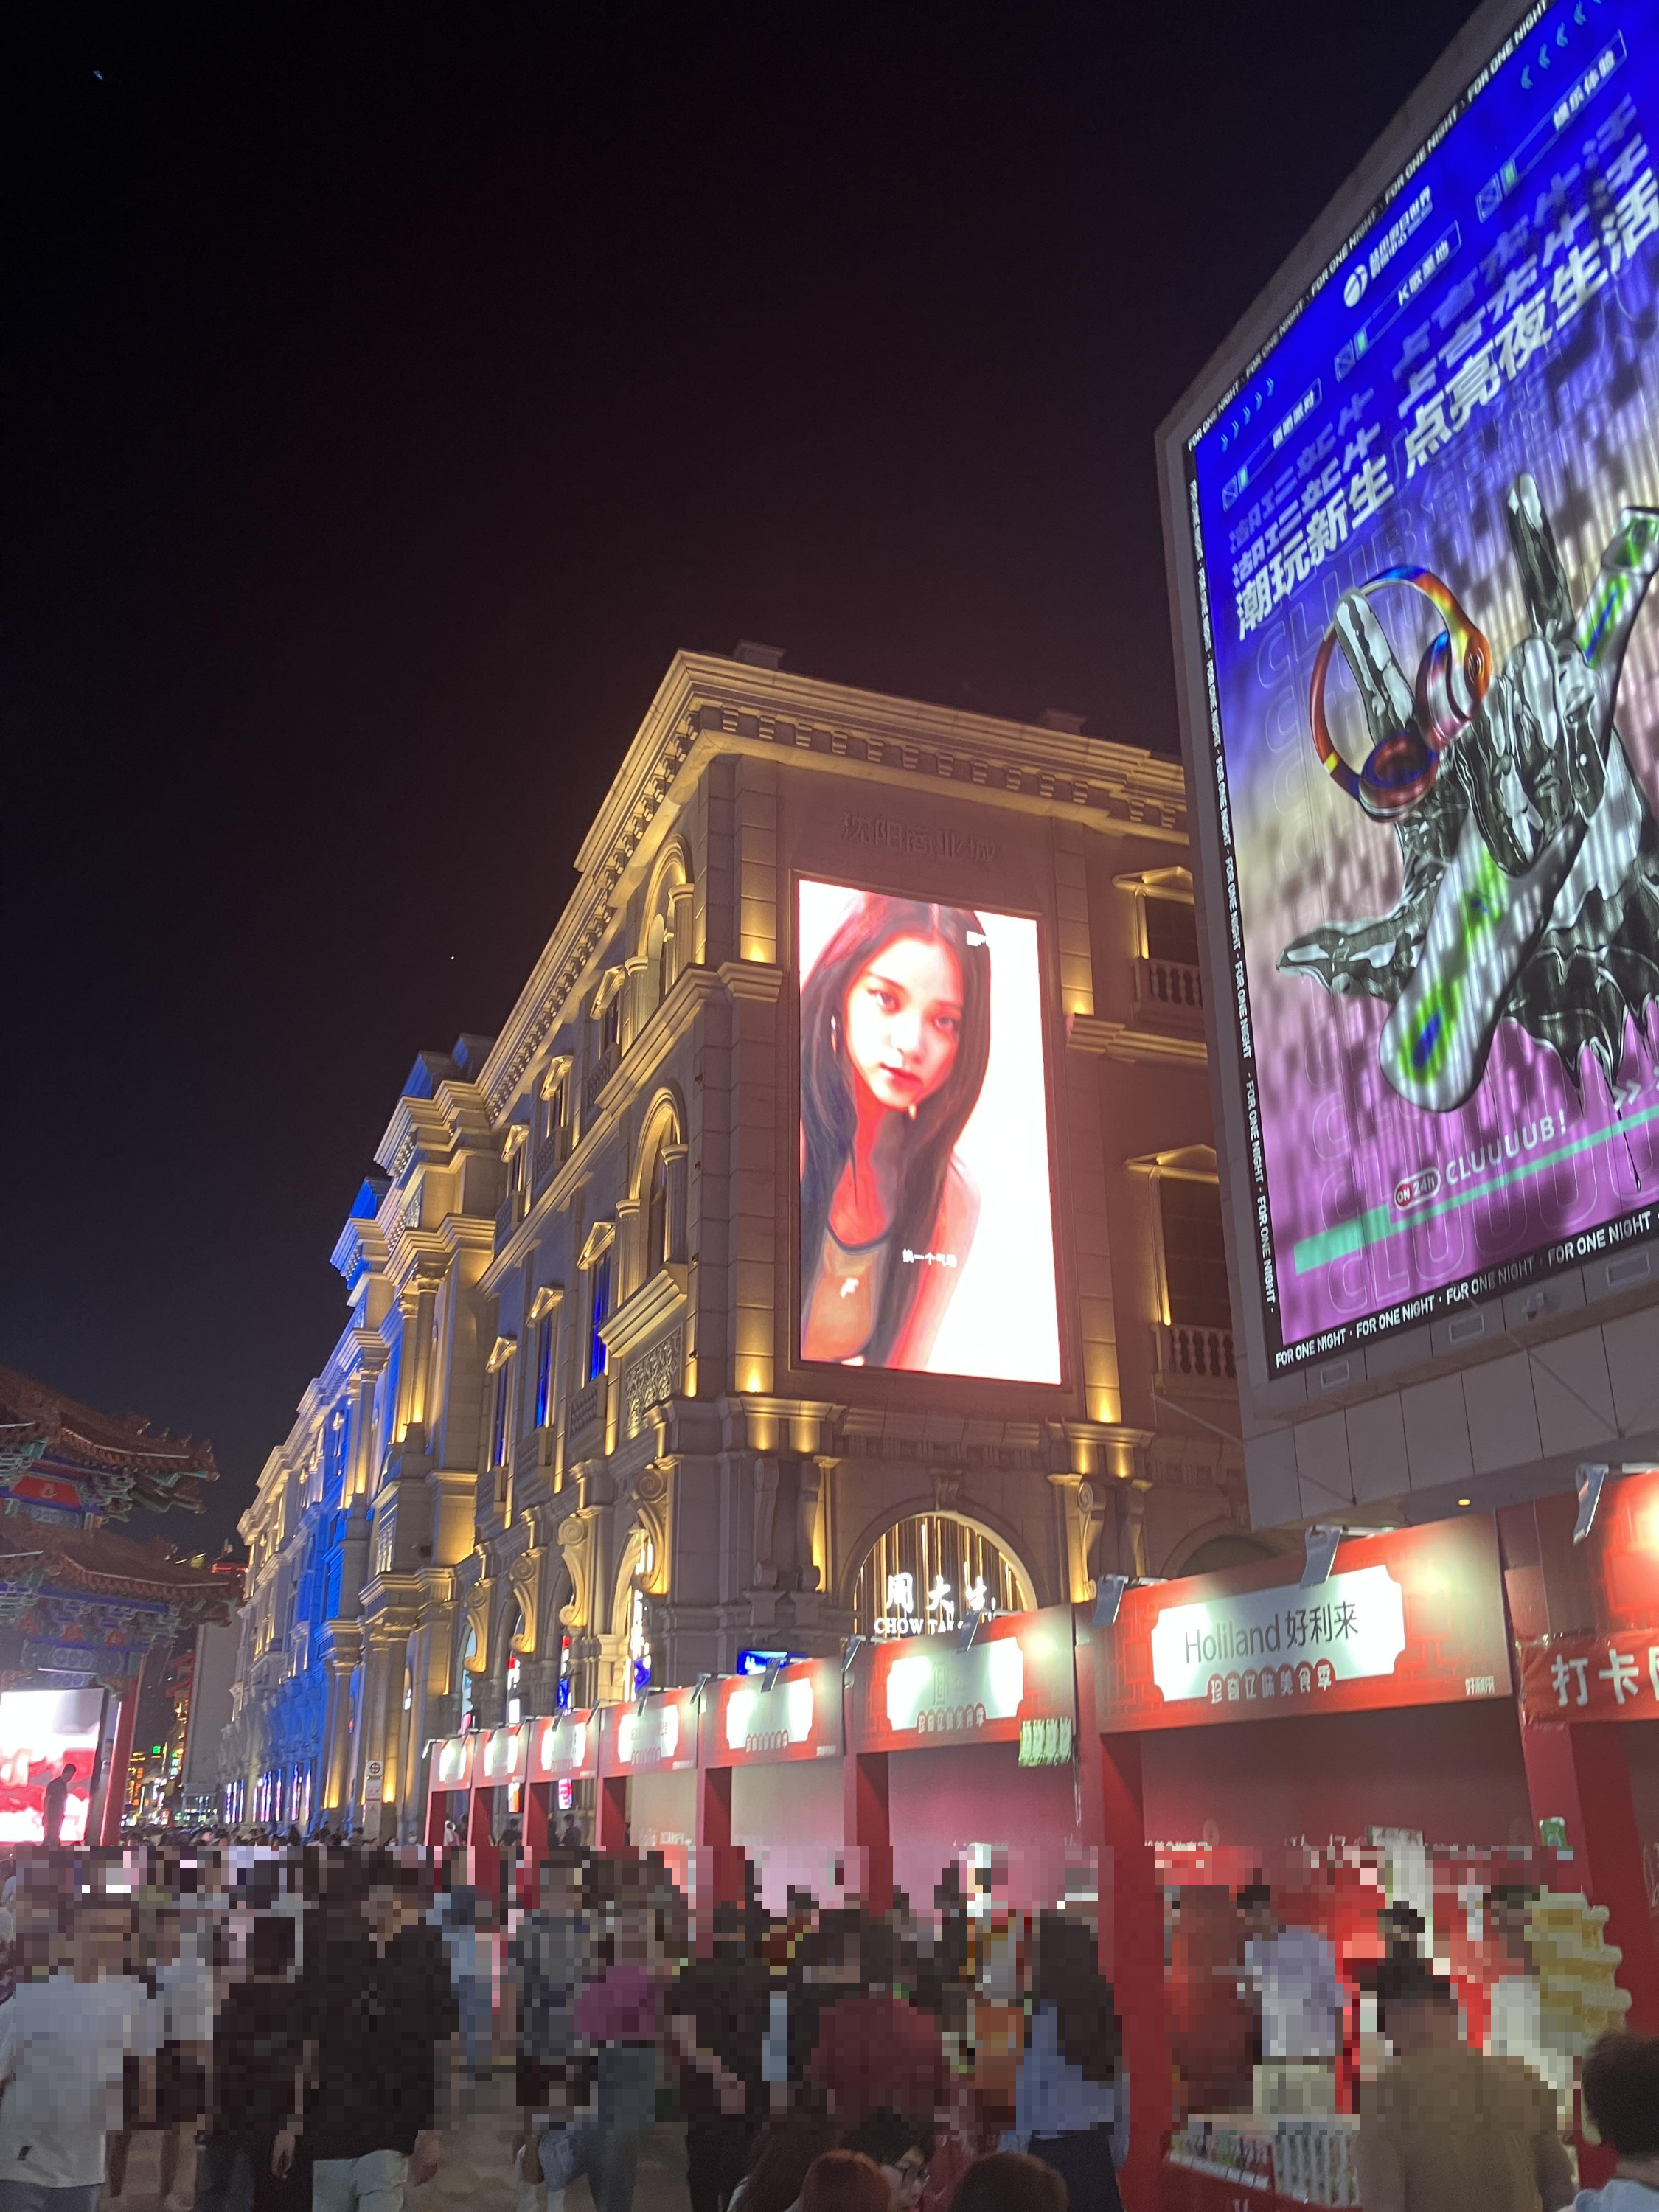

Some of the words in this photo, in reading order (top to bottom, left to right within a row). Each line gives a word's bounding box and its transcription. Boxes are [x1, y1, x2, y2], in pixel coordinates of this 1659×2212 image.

[1188, 428, 1202, 452] FOR
[1203, 408, 1217, 434] ONE
[1217, 380, 1239, 414] NIGHT
[1311, 268, 1328, 297] FOR
[1329, 243, 1348, 274] ONE
[1349, 207, 1376, 250] NIGHT
[1385, 173, 1404, 204] FOR
[1405, 145, 1427, 179] ONE
[1427, 104, 1458, 153] NIGHT
[1467, 68, 1489, 102] FOR
[1490, 38, 1513, 74] ONE
[1405, 167, 1659, 481] 点亮夜生活
[1236, 453, 1394, 641] 潮玩新生
[1216, 756, 1224, 783] FOR
[1218, 781, 1227, 810] ONE
[1220, 808, 1231, 846] NIGHT
[1225, 855, 1234, 884] FOR
[1228, 883, 1237, 911] ONE
[1230, 911, 1240, 950] NIGHT
[1234, 961, 1245, 990] FOR
[1237, 989, 1247, 1019] ONE
[1240, 1017, 1251, 1058] NIGHT
[1245, 1079, 1256, 1110] FOR
[1249, 1108, 1259, 1141] ONE
[1251, 1140, 1263, 1182] NIGHT
[1397, 1187, 1411, 1203] ON
[1413, 1178, 1436, 1196] 24h
[1257, 1195, 1267, 1227] FOR
[1260, 1226, 1270, 1259] ONE
[1263, 1259, 1276, 1303] NIGHT
[1276, 1348, 1294, 1368] FOR
[1295, 1340, 1315, 1360] ONE
[1317, 1327, 1346, 1352] NIGHT
[1356, 1318, 1377, 1338] FOR
[1379, 1310, 1400, 1330] ONE
[1402, 1294, 1435, 1322] NIGHT
[1447, 1282, 1469, 1305] FOR
[1471, 1271, 1495, 1295] ONE
[1498, 1256, 1534, 1284] NIGHT
[1548, 1242, 1574, 1267] FOR
[1576, 1229, 1606, 1255] ONE
[1608, 1211, 1651, 1245] NIGHT
[886, 1572, 987, 1613] 周大生
[874, 1618, 924, 1635] CHOW
[1185, 1613, 1281, 1664] Holiland
[1285, 1601, 1359, 1650] 好利来
[1551, 1646, 1659, 1707] 打卡
